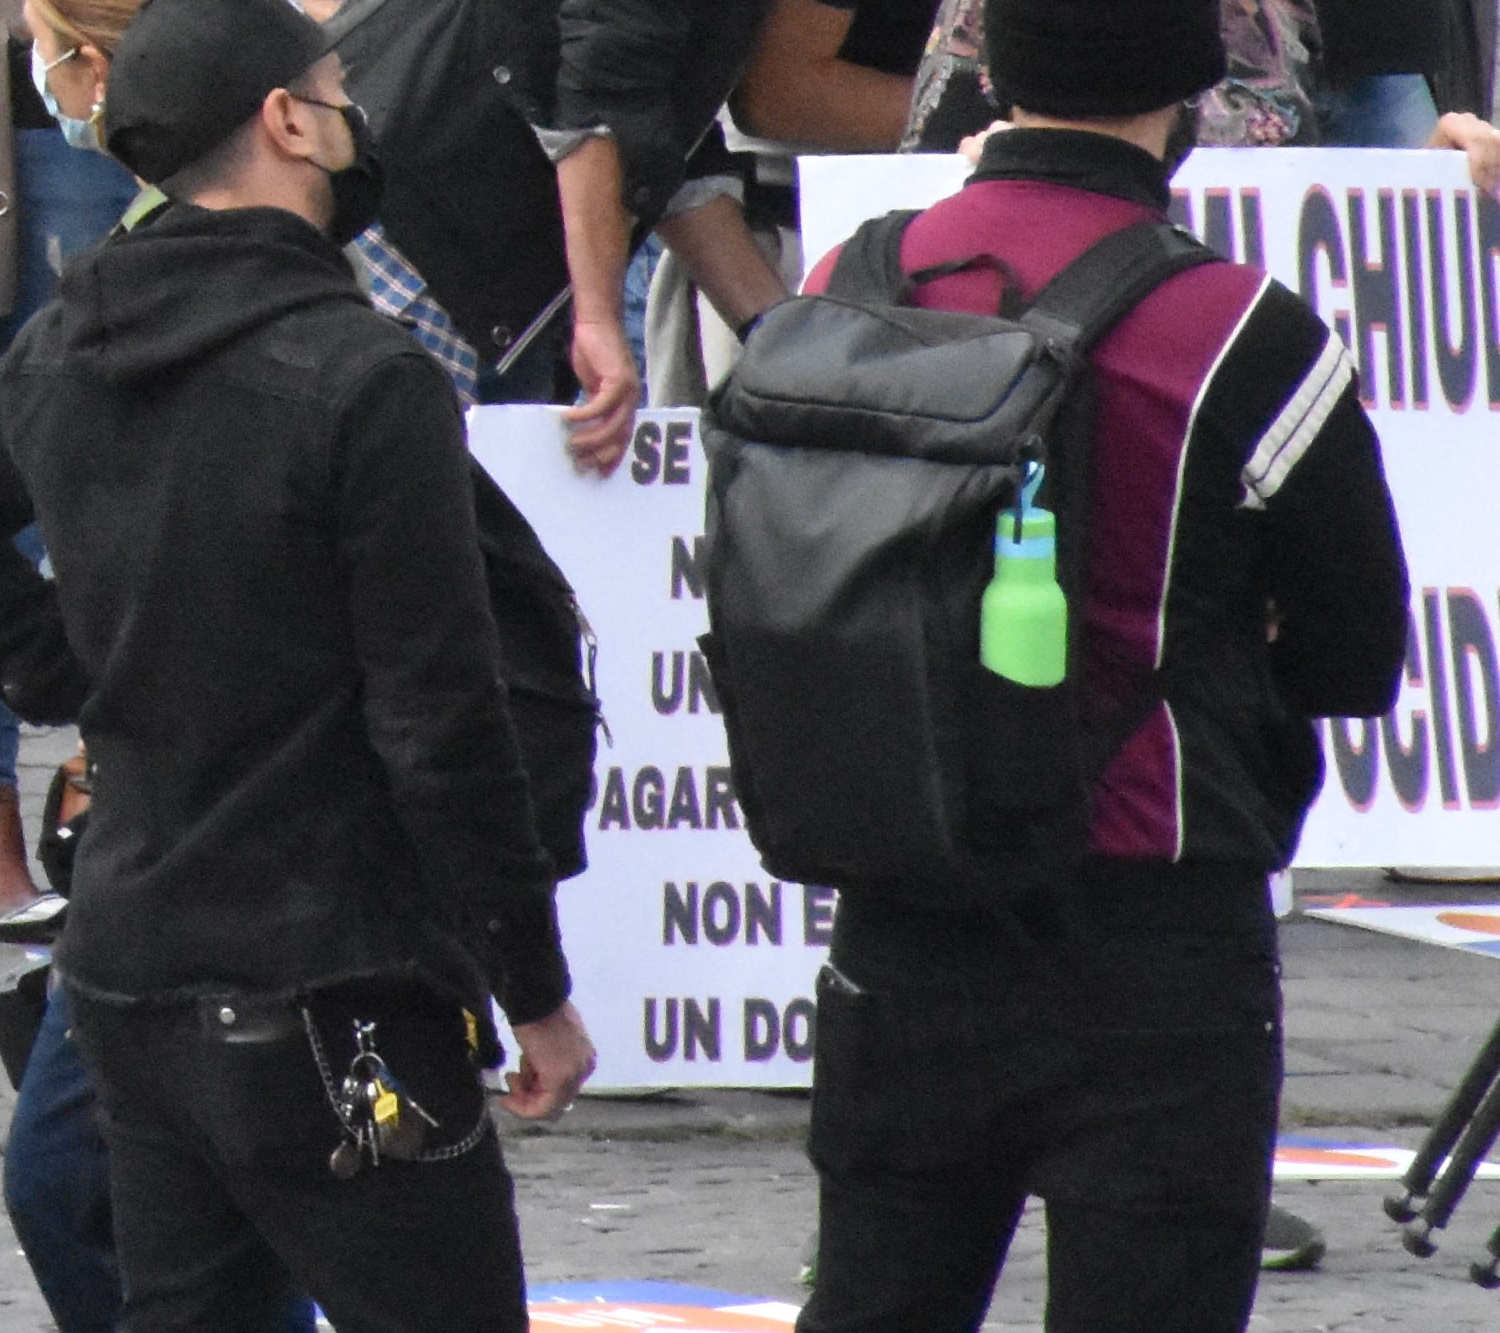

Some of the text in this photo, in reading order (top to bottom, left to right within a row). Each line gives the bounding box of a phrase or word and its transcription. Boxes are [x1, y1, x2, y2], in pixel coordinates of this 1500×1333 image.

[630, 420, 693, 486] SE
[594, 764, 745, 831] AGAR
[662, 881, 784, 946] NON
[643, 996, 818, 1063] UN DO
